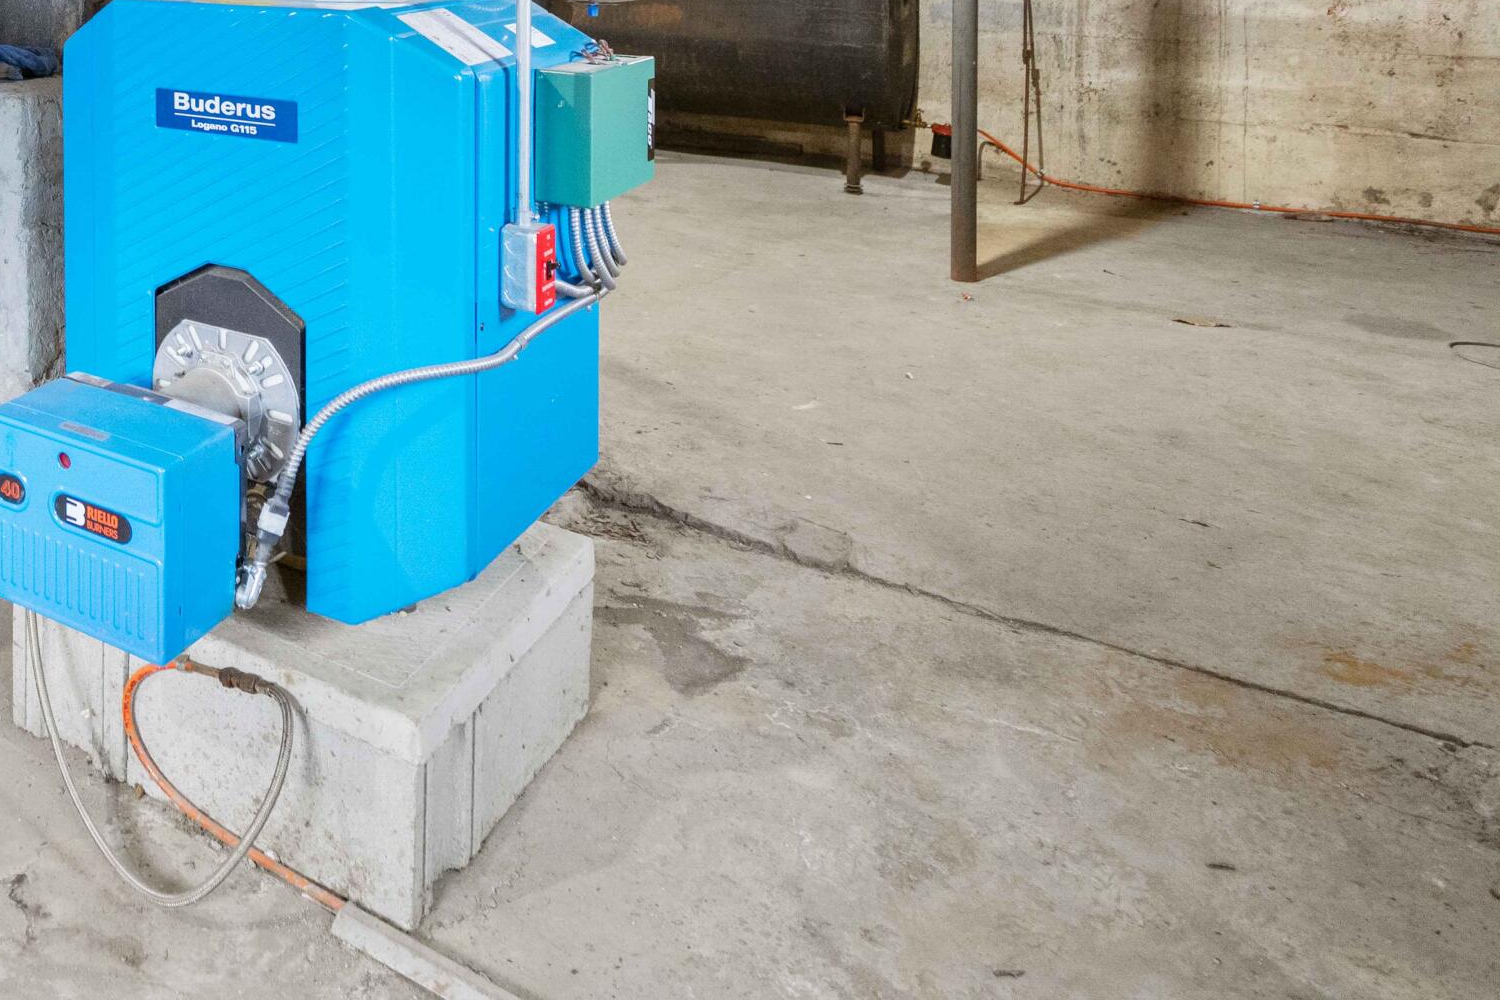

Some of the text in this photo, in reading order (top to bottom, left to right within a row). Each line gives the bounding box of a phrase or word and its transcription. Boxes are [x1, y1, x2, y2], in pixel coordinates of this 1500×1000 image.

[173, 91, 276, 121] Buderus
[191, 119, 258, 135] Logano G115
[0, 479, 21, 500] 40
[86, 505, 119, 529] RIELLO
[86, 523, 118, 541] BURNERS
